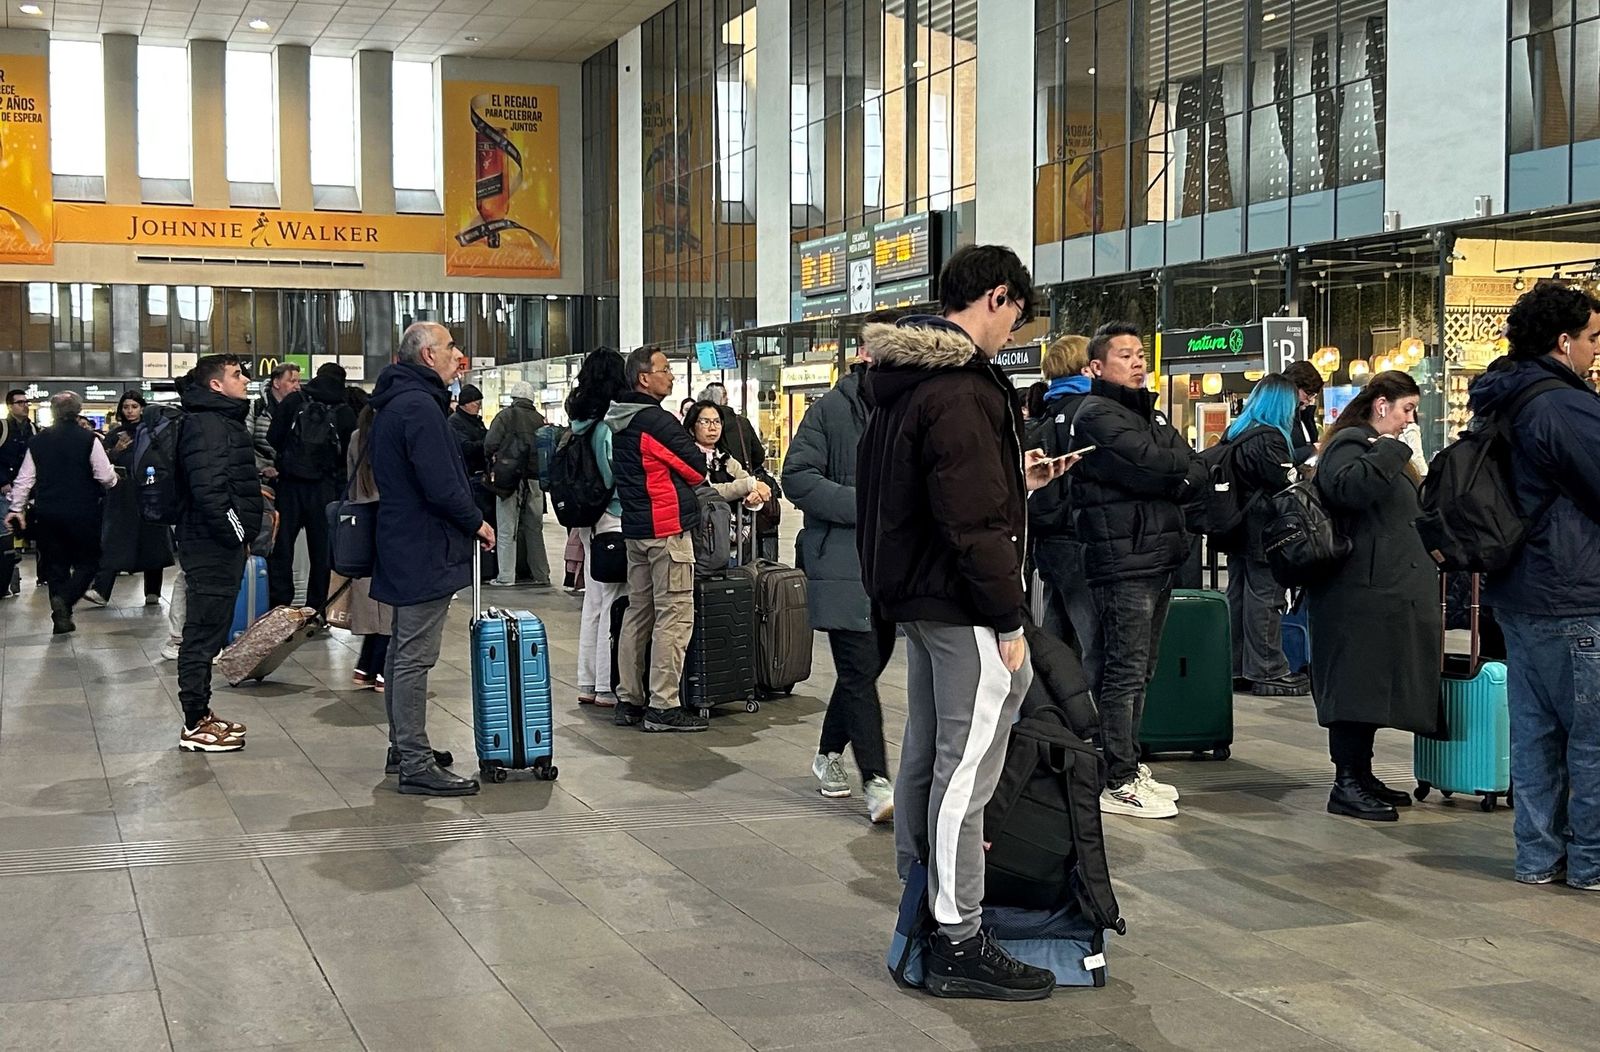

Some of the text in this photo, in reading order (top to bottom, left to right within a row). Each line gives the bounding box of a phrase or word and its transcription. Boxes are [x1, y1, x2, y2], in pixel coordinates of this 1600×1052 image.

[6, 94, 35, 111] AÑOS
[492, 94, 538, 109] EL REGALO
[1, 112, 42, 123] DE ESPERA
[485, 108, 542, 122] PARA CELEBRAR
[510, 122, 538, 132] JUNTOS
[127, 215, 379, 243] JOHNNIE WALKER
[1187, 334, 1227, 352] natura
